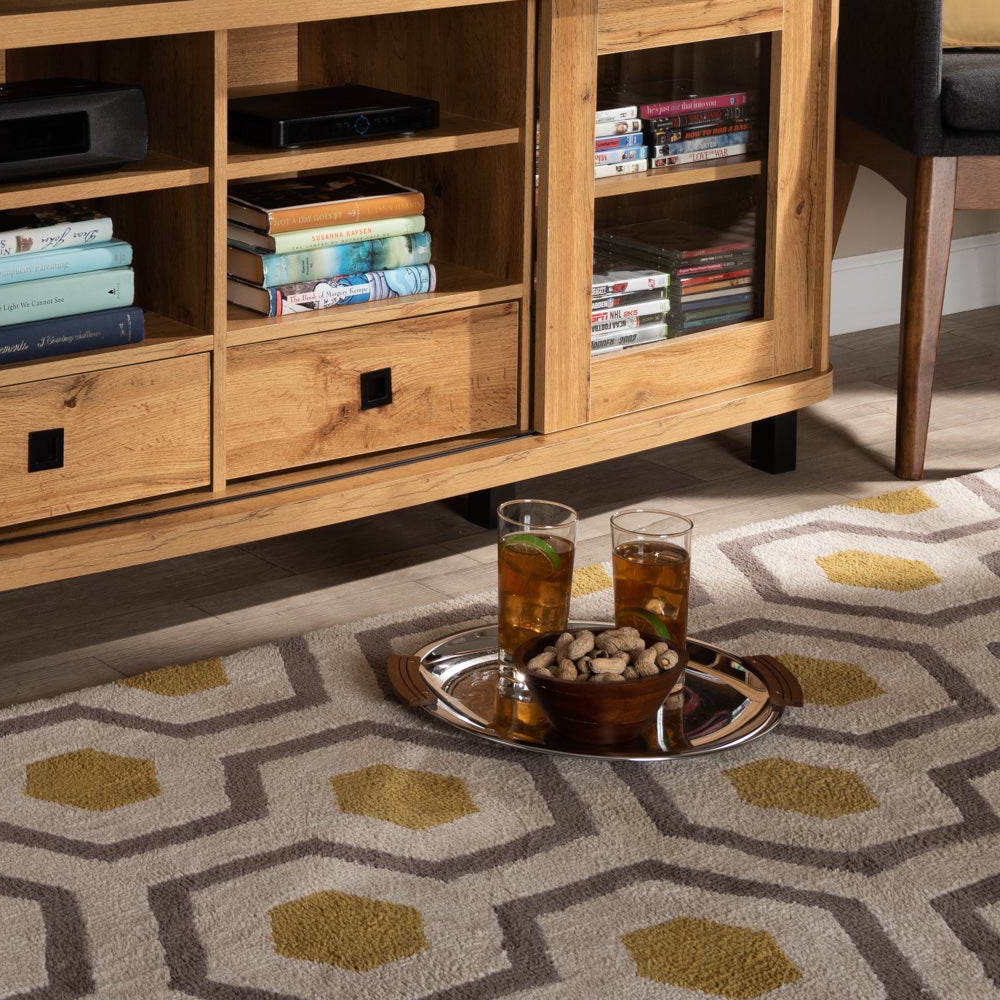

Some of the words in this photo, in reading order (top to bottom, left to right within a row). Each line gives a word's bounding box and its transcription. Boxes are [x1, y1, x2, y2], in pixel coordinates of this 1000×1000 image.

[681, 102, 692, 110] that
[714, 148, 728, 157] WAR
[274, 218, 289, 226] NOT
[298, 214, 312, 224] DAY
[314, 213, 332, 222] GOES
[74, 230, 98, 242] Dear
[312, 232, 344, 242] SUSANNA
[346, 228, 372, 237] KAYSEN
[289, 295, 301, 304] The
[302, 293, 317, 302] Book
[3, 302, 20, 312] Light
[20, 301, 30, 309] We
[31, 298, 53, 308] Cannot
[592, 312, 608, 322] SPN
[610, 310, 622, 320] NHL
[592, 322, 612, 332] FOOTBA
[612, 320, 626, 329] NCAA
